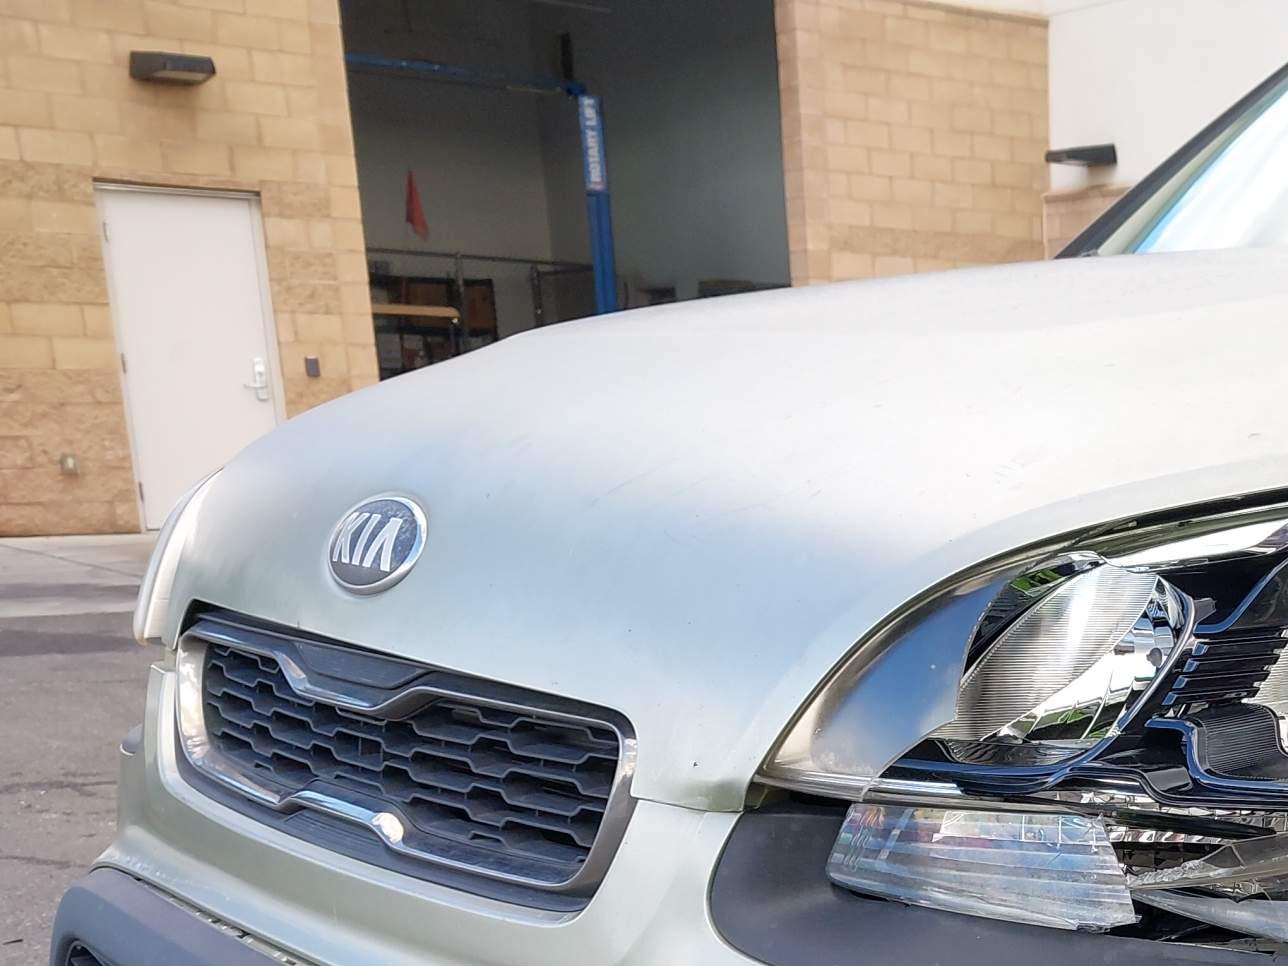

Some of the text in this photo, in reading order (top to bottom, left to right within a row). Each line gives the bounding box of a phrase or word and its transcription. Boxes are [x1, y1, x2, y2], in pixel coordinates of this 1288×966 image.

[583, 98, 601, 182] ROTARY LIFT
[332, 511, 403, 572] KIA
